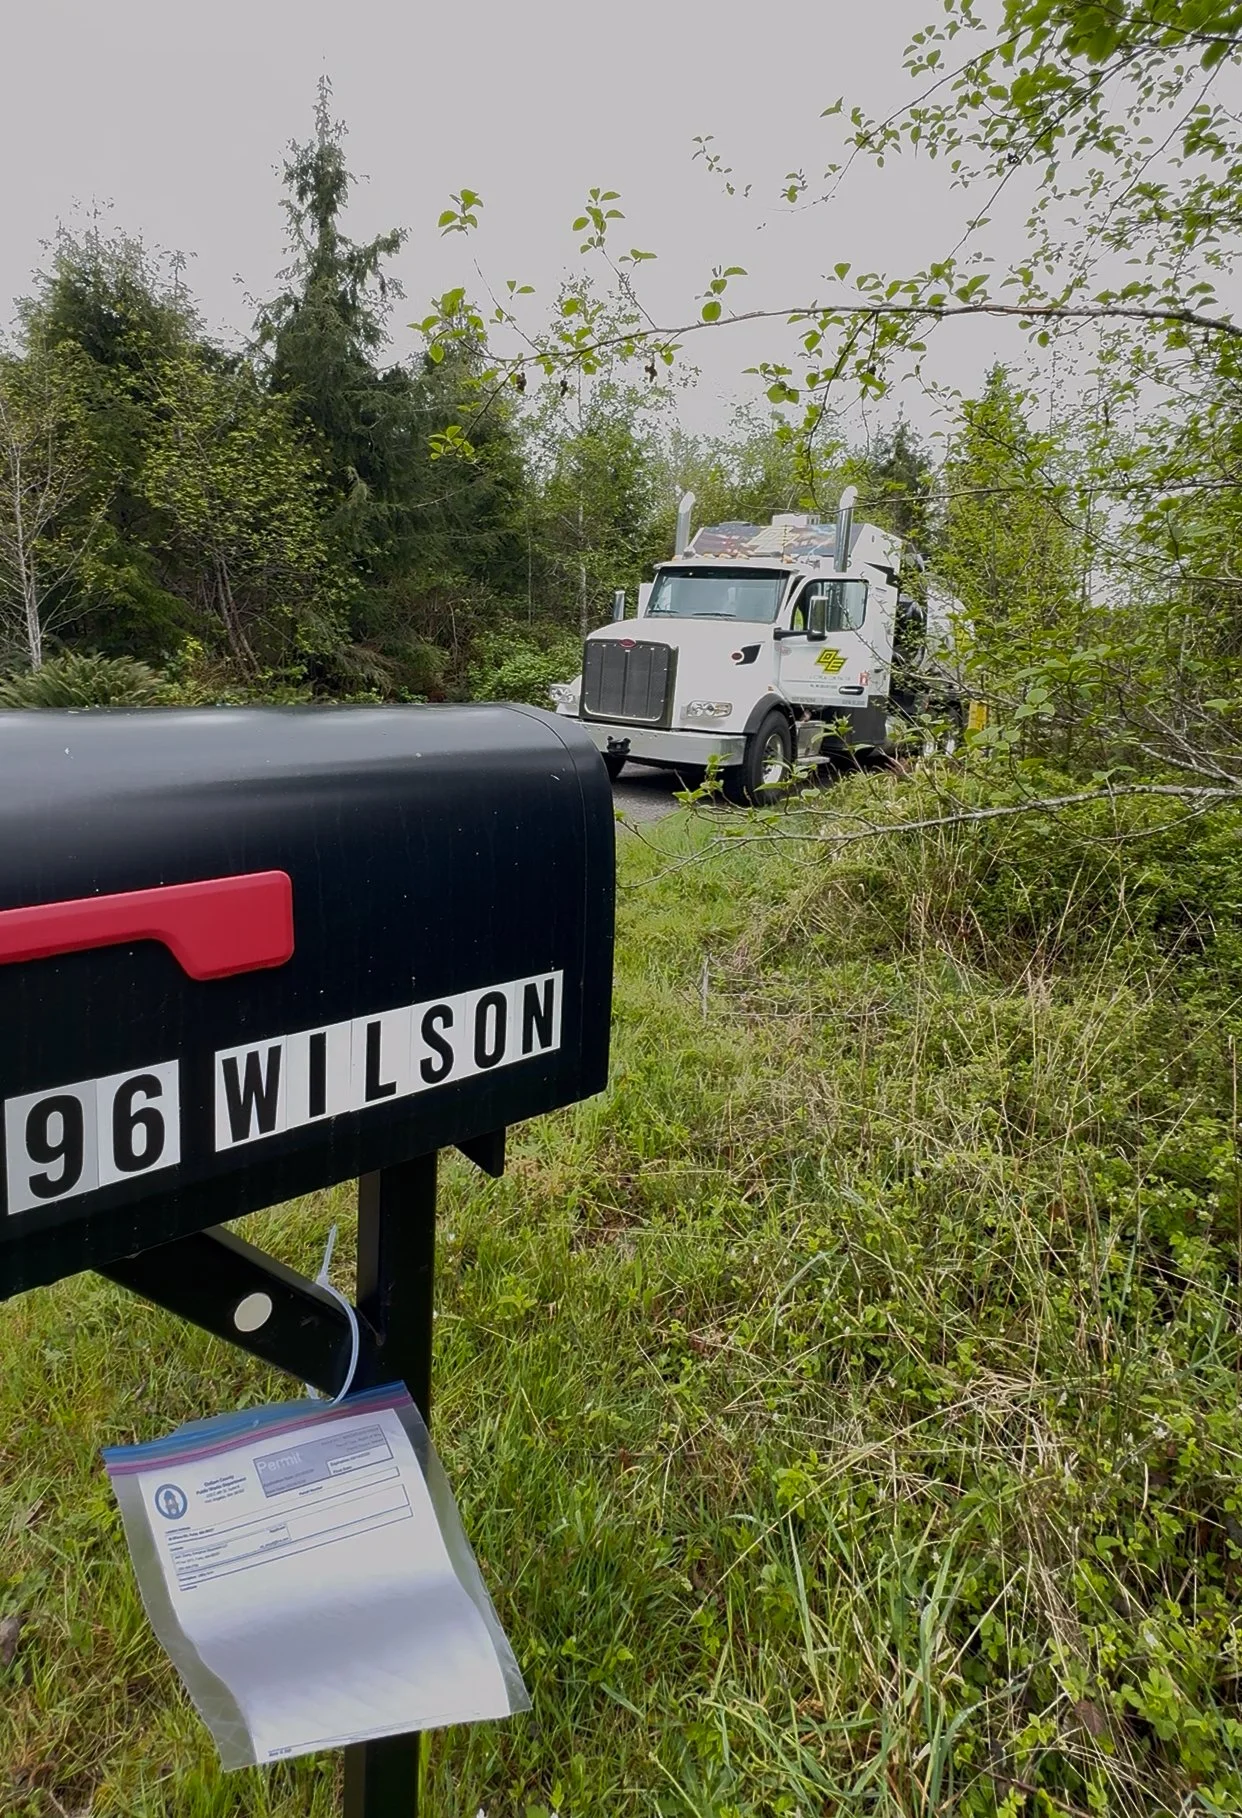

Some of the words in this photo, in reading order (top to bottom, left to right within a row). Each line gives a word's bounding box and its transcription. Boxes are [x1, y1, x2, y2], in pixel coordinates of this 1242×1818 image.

[25, 1073, 165, 1199] 96
[221, 978, 555, 1143] WILSON
[257, 1452, 303, 1474] Permit
